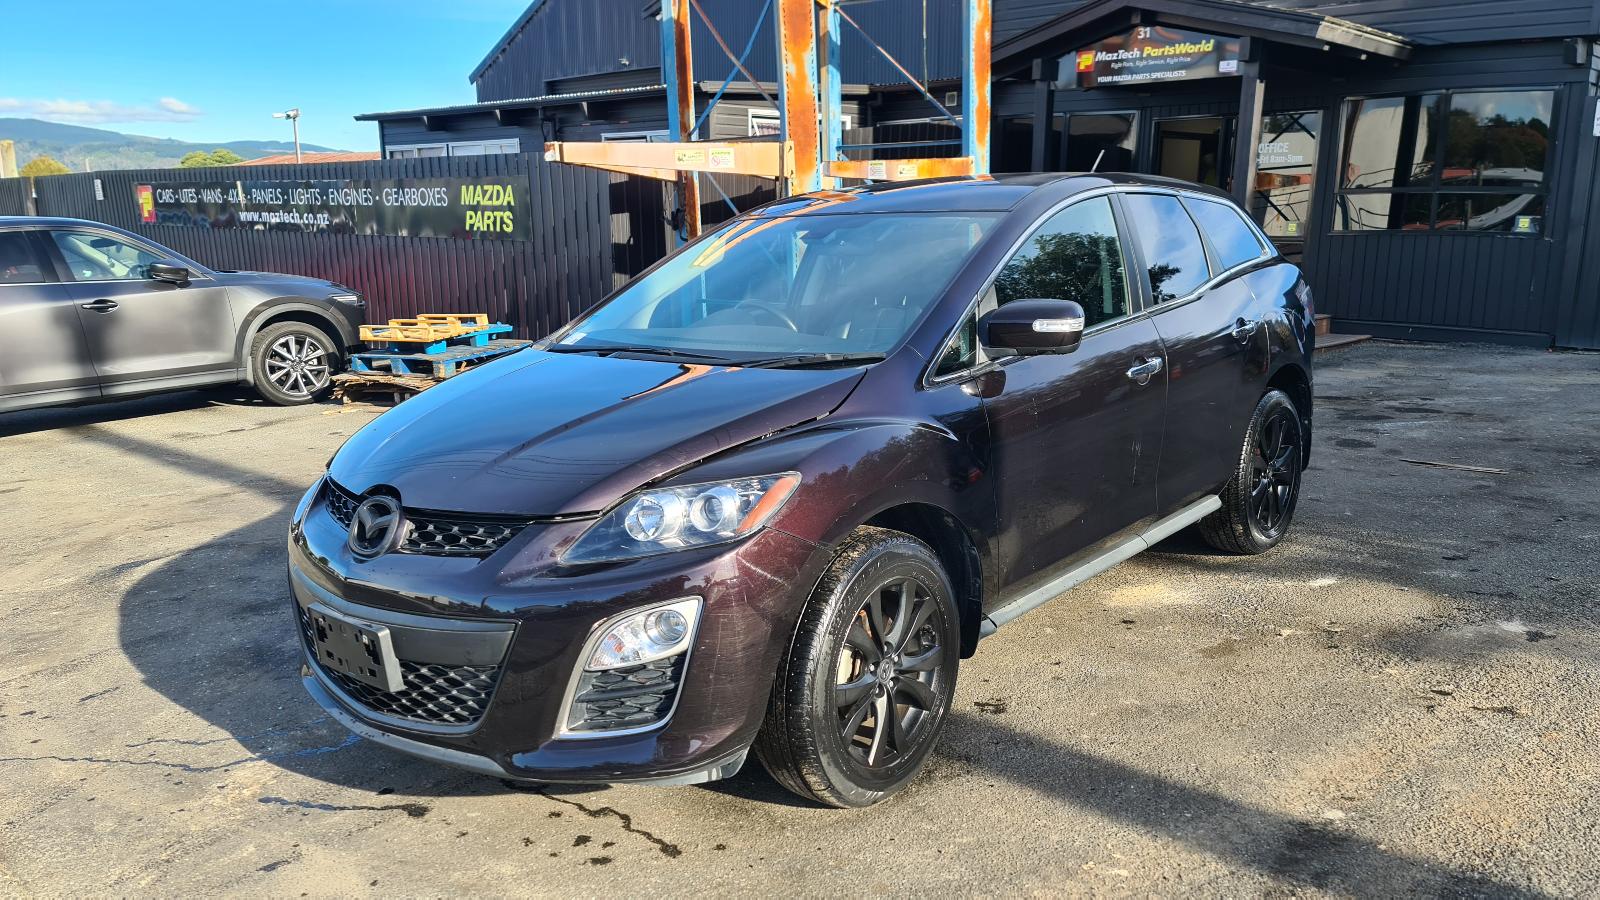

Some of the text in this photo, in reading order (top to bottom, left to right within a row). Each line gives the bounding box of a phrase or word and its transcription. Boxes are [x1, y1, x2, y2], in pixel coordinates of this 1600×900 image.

[1137, 27, 1151, 39] 31
[1095, 39, 1215, 62] MazTech PartsWorld
[1150, 70, 1186, 79] SPECIALISTS
[1258, 143, 1289, 153] OFFICE
[156, 188, 175, 203] CARS
[178, 188, 198, 204] UTES
[200, 188, 223, 204] VANS
[251, 188, 283, 205] PANELS
[289, 188, 321, 206] LIGHTS
[328, 188, 373, 206] ENGINES
[383, 187, 449, 207] GEARBOXES
[461, 184, 515, 207] MAZDA
[238, 209, 330, 225] www.maztech.co.nz
[465, 210, 514, 233] PARTS
